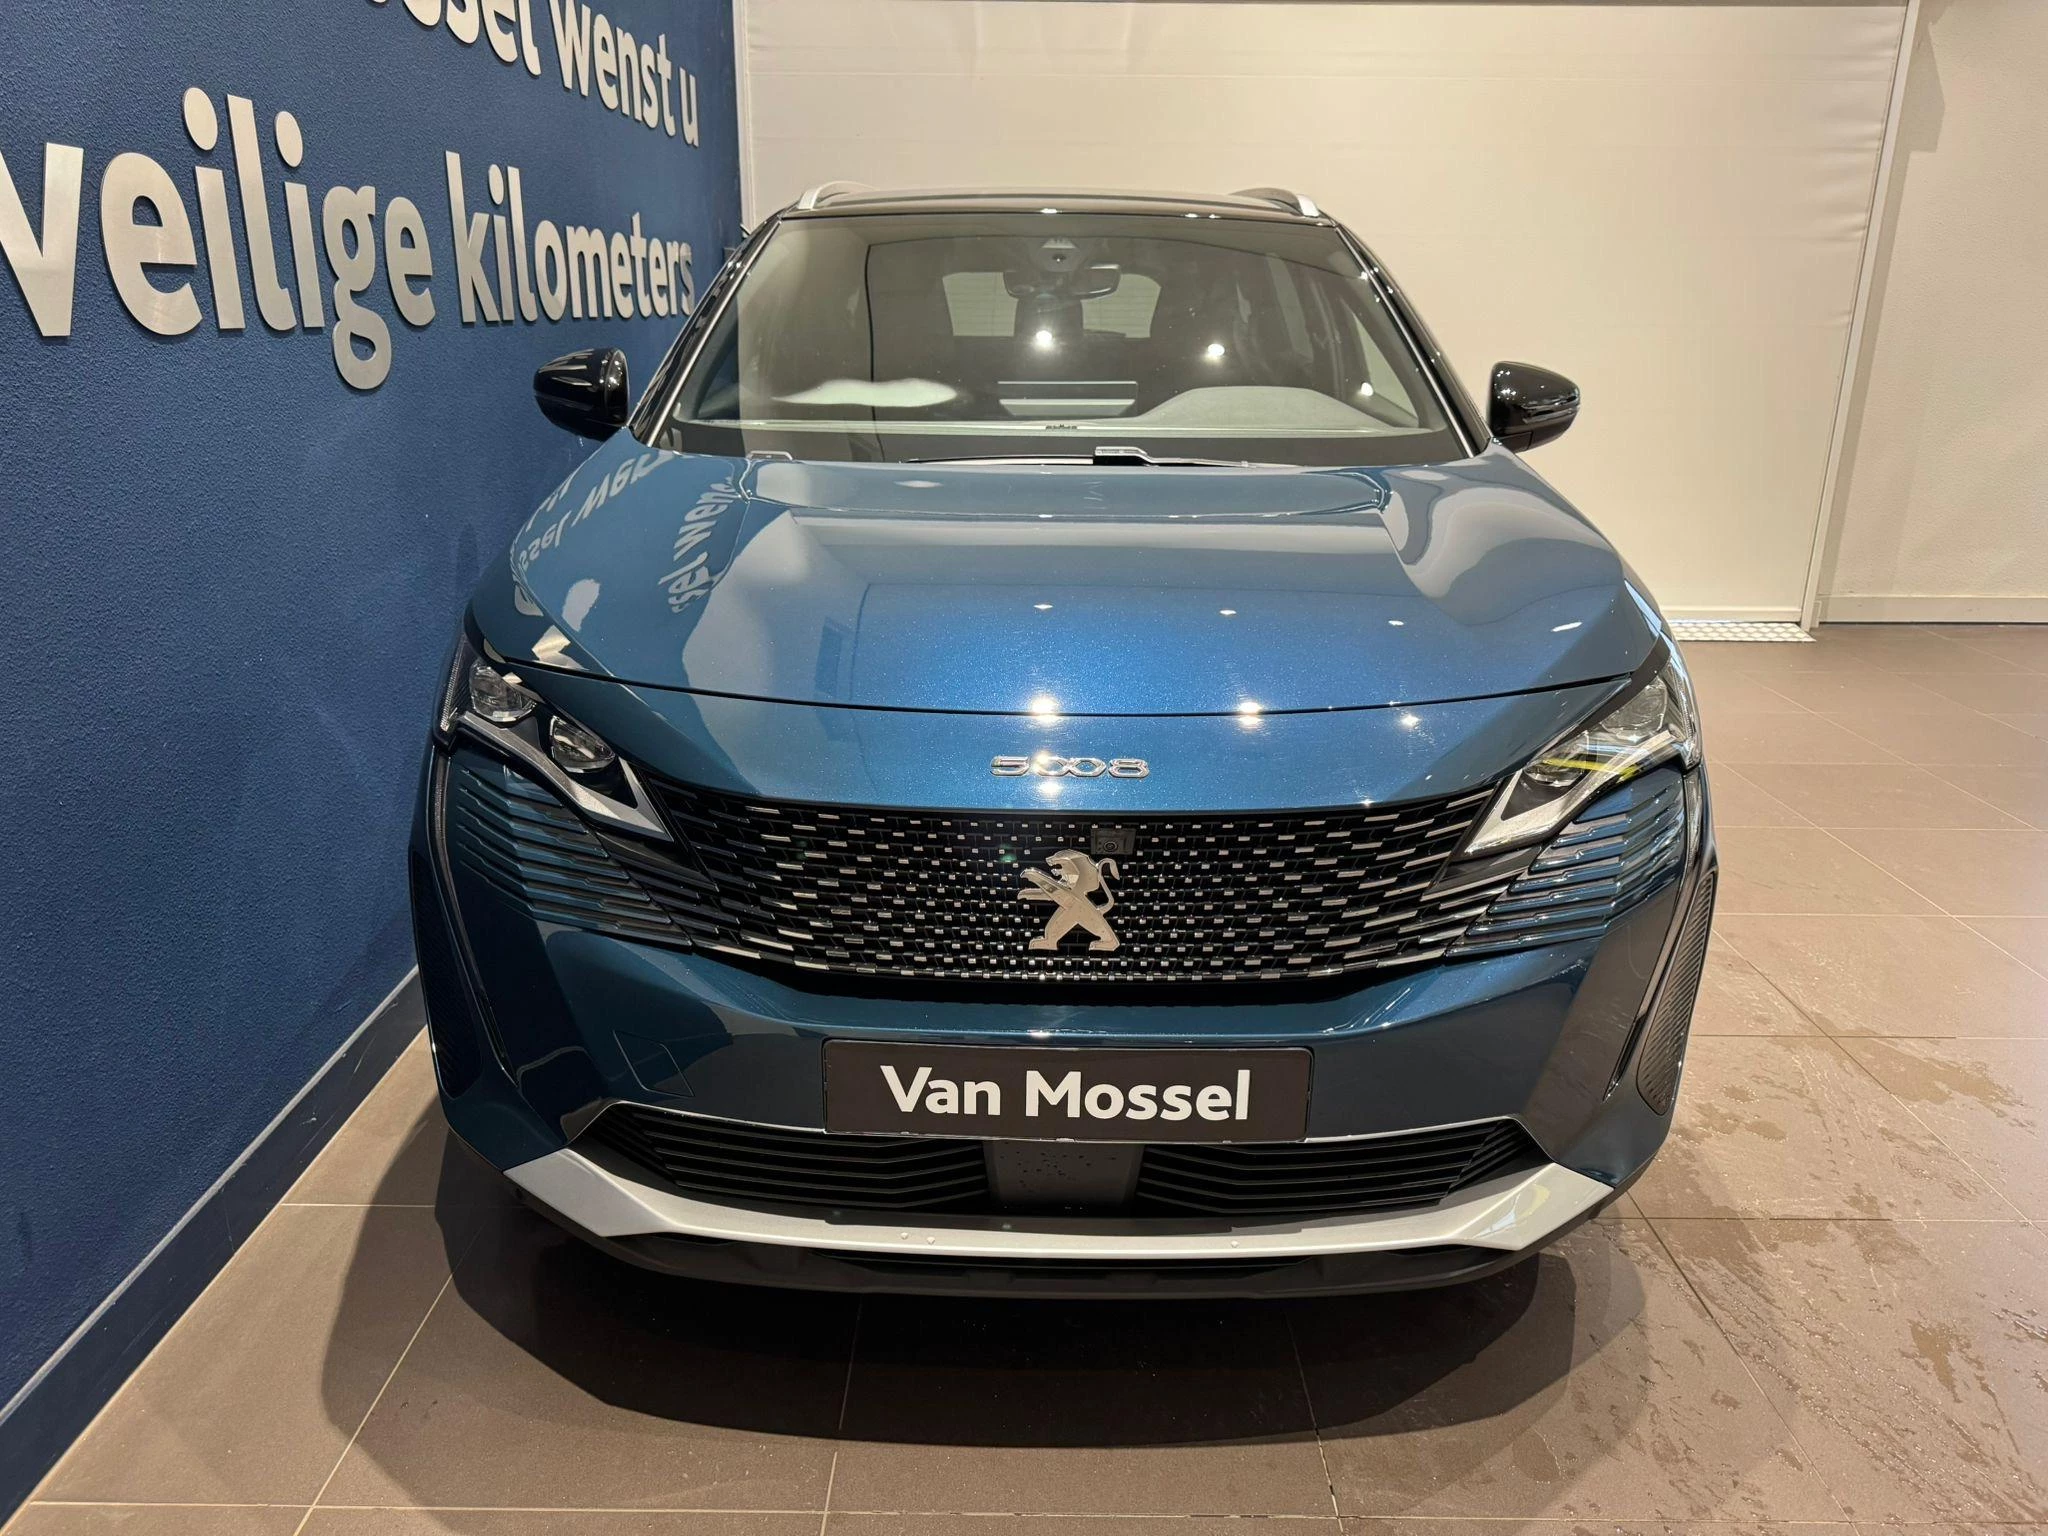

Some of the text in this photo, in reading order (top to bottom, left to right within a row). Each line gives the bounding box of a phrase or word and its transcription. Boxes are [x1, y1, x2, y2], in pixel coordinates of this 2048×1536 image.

[549, 0, 676, 137] wenst
[679, 67, 699, 147] u
[0, 87, 695, 390] veilige kilometers
[990, 755, 1150, 778] 5008
[880, 1065, 1251, 1121] Van Mossel
